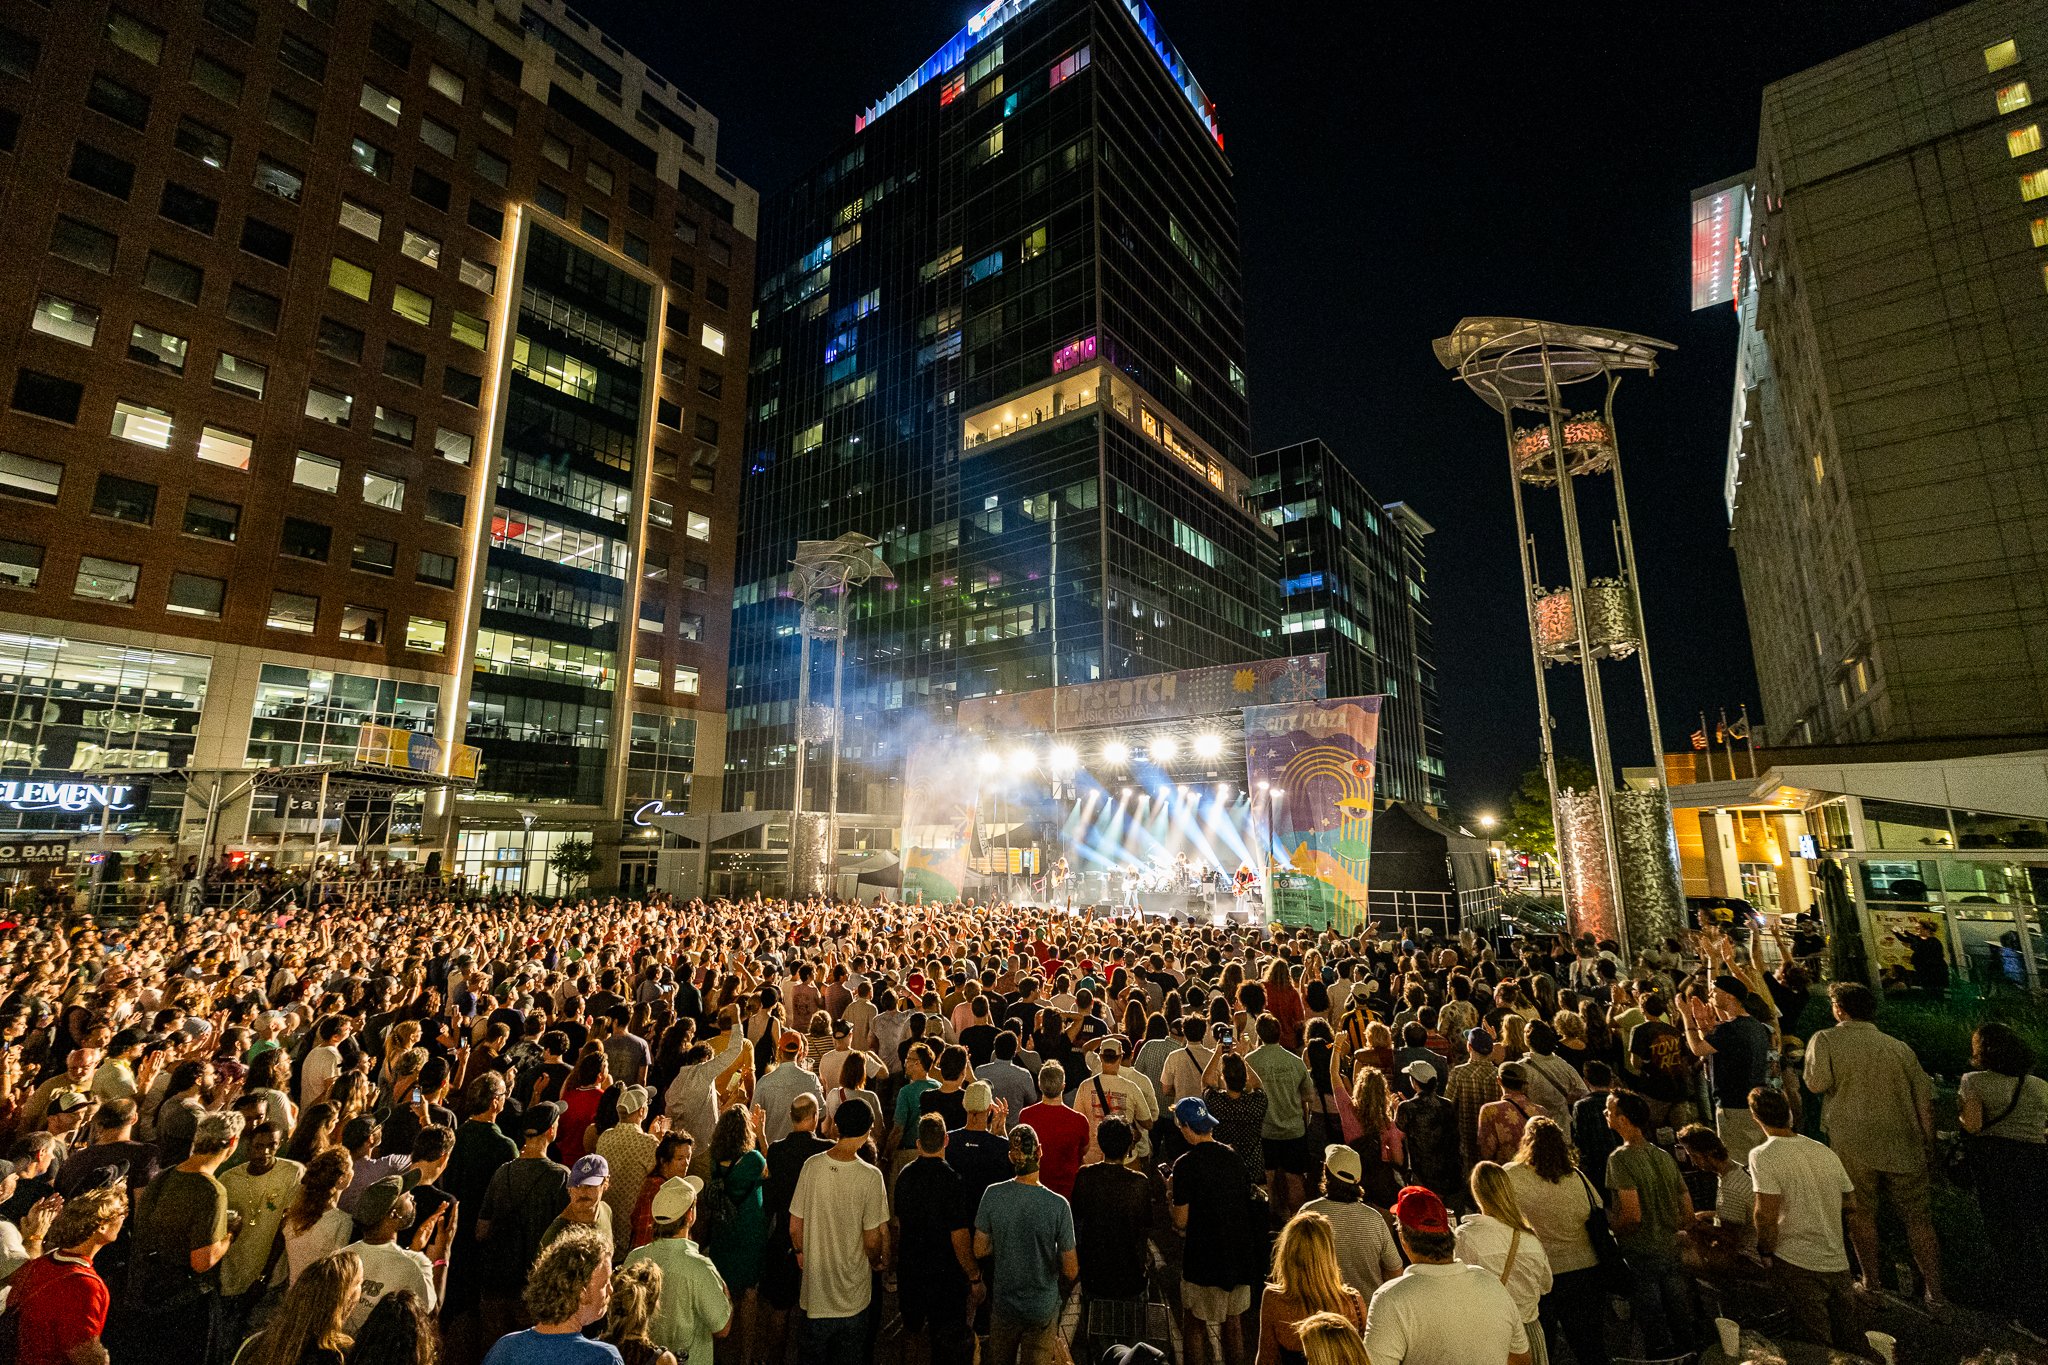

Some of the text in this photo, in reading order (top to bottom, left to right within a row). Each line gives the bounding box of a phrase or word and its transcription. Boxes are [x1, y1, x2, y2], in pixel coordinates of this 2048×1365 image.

[1074, 704, 1152, 723] MUSIC FESTIVAL
[1266, 712, 1346, 731] CITY PLAZA
[22, 845, 66, 858] BAR
[1649, 1037, 1680, 1055] TONY
